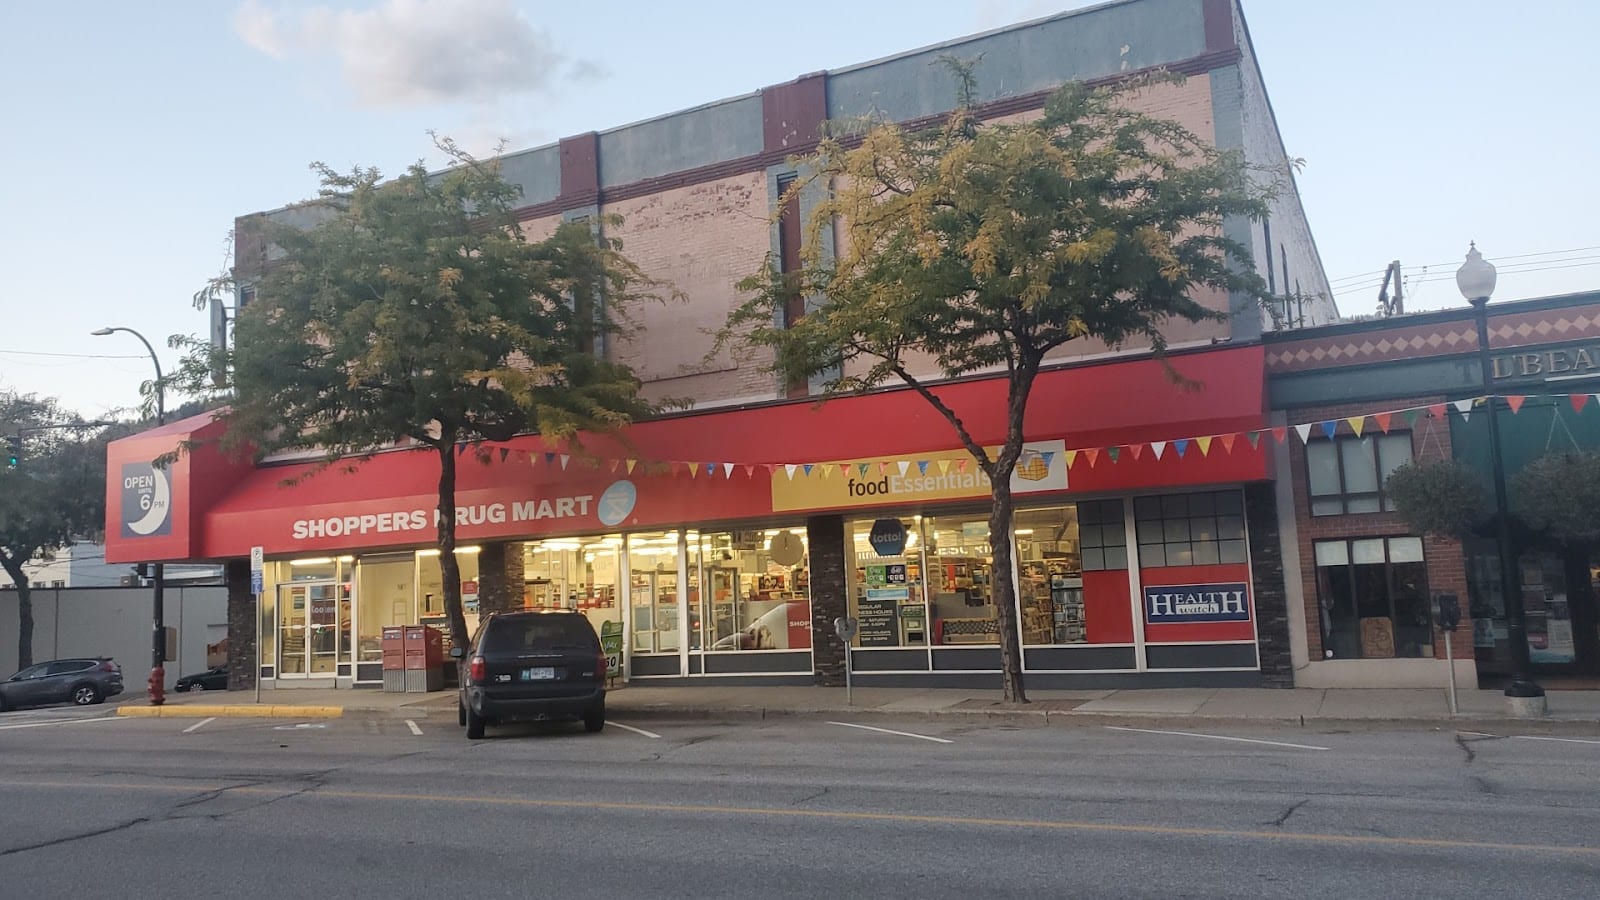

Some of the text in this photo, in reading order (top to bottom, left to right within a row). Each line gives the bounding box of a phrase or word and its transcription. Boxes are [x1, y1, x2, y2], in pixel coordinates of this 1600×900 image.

[1491, 348, 1600, 379] L'BEA
[124, 475, 153, 489] OPEN
[140, 494, 151, 511] 6
[292, 510, 428, 539] SHOPPERS
[512, 495, 593, 522] MART
[1149, 591, 1246, 616] HEALTH
[1179, 604, 1215, 614] watch
